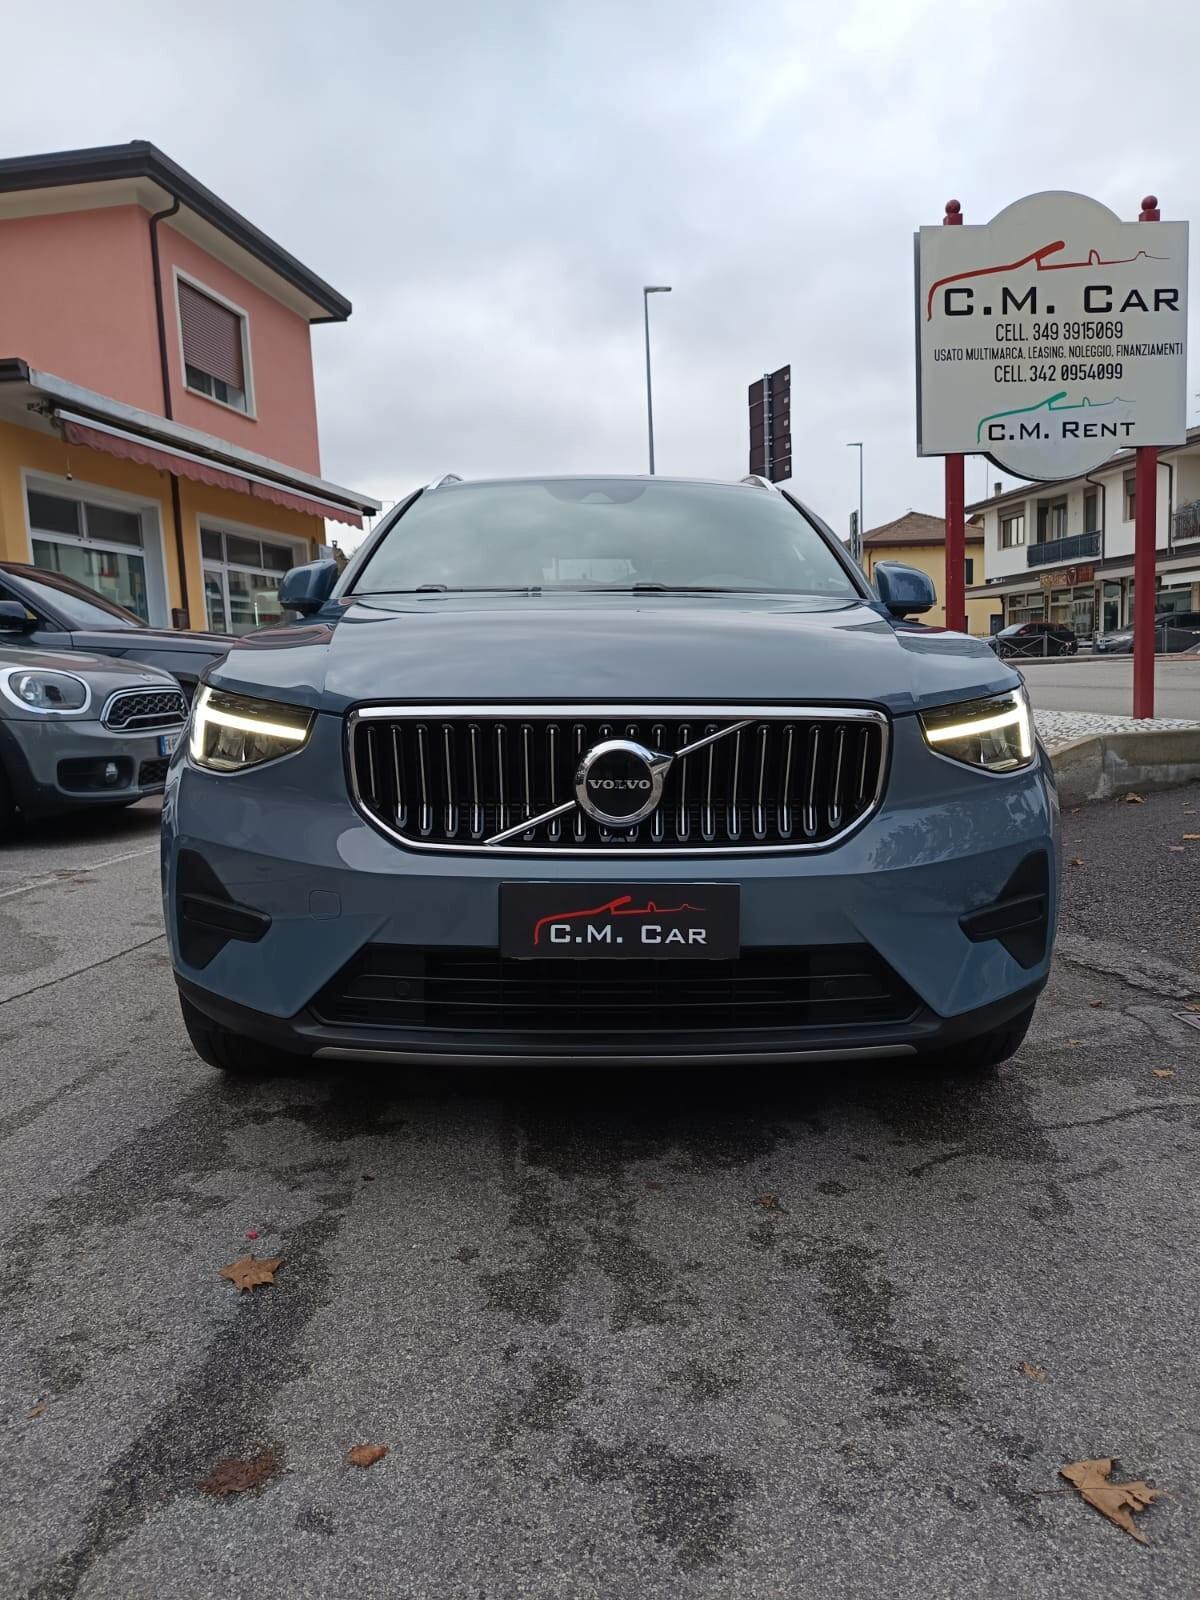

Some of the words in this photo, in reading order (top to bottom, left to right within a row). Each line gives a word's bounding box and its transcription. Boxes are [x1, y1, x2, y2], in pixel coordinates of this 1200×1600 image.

[944, 286, 1055, 316] C.M.
[1083, 285, 1180, 314] CAR
[995, 323, 1029, 342] CELL.
[1033, 322, 1059, 341] 349
[1063, 321, 1123, 341] 3915069
[934, 348, 963, 361] USATO
[1116, 343, 1183, 356] FINANZIAMENTI
[994, 365, 1027, 383] CELL.
[1029, 364, 1057, 382] 342
[1061, 363, 1123, 381] 0954099
[988, 422, 1049, 441] C.M.
[1062, 421, 1136, 438] RENT
[588, 779, 651, 790] VOLVO
[550, 924, 623, 944] C.M.
[641, 924, 708, 944] CAR
